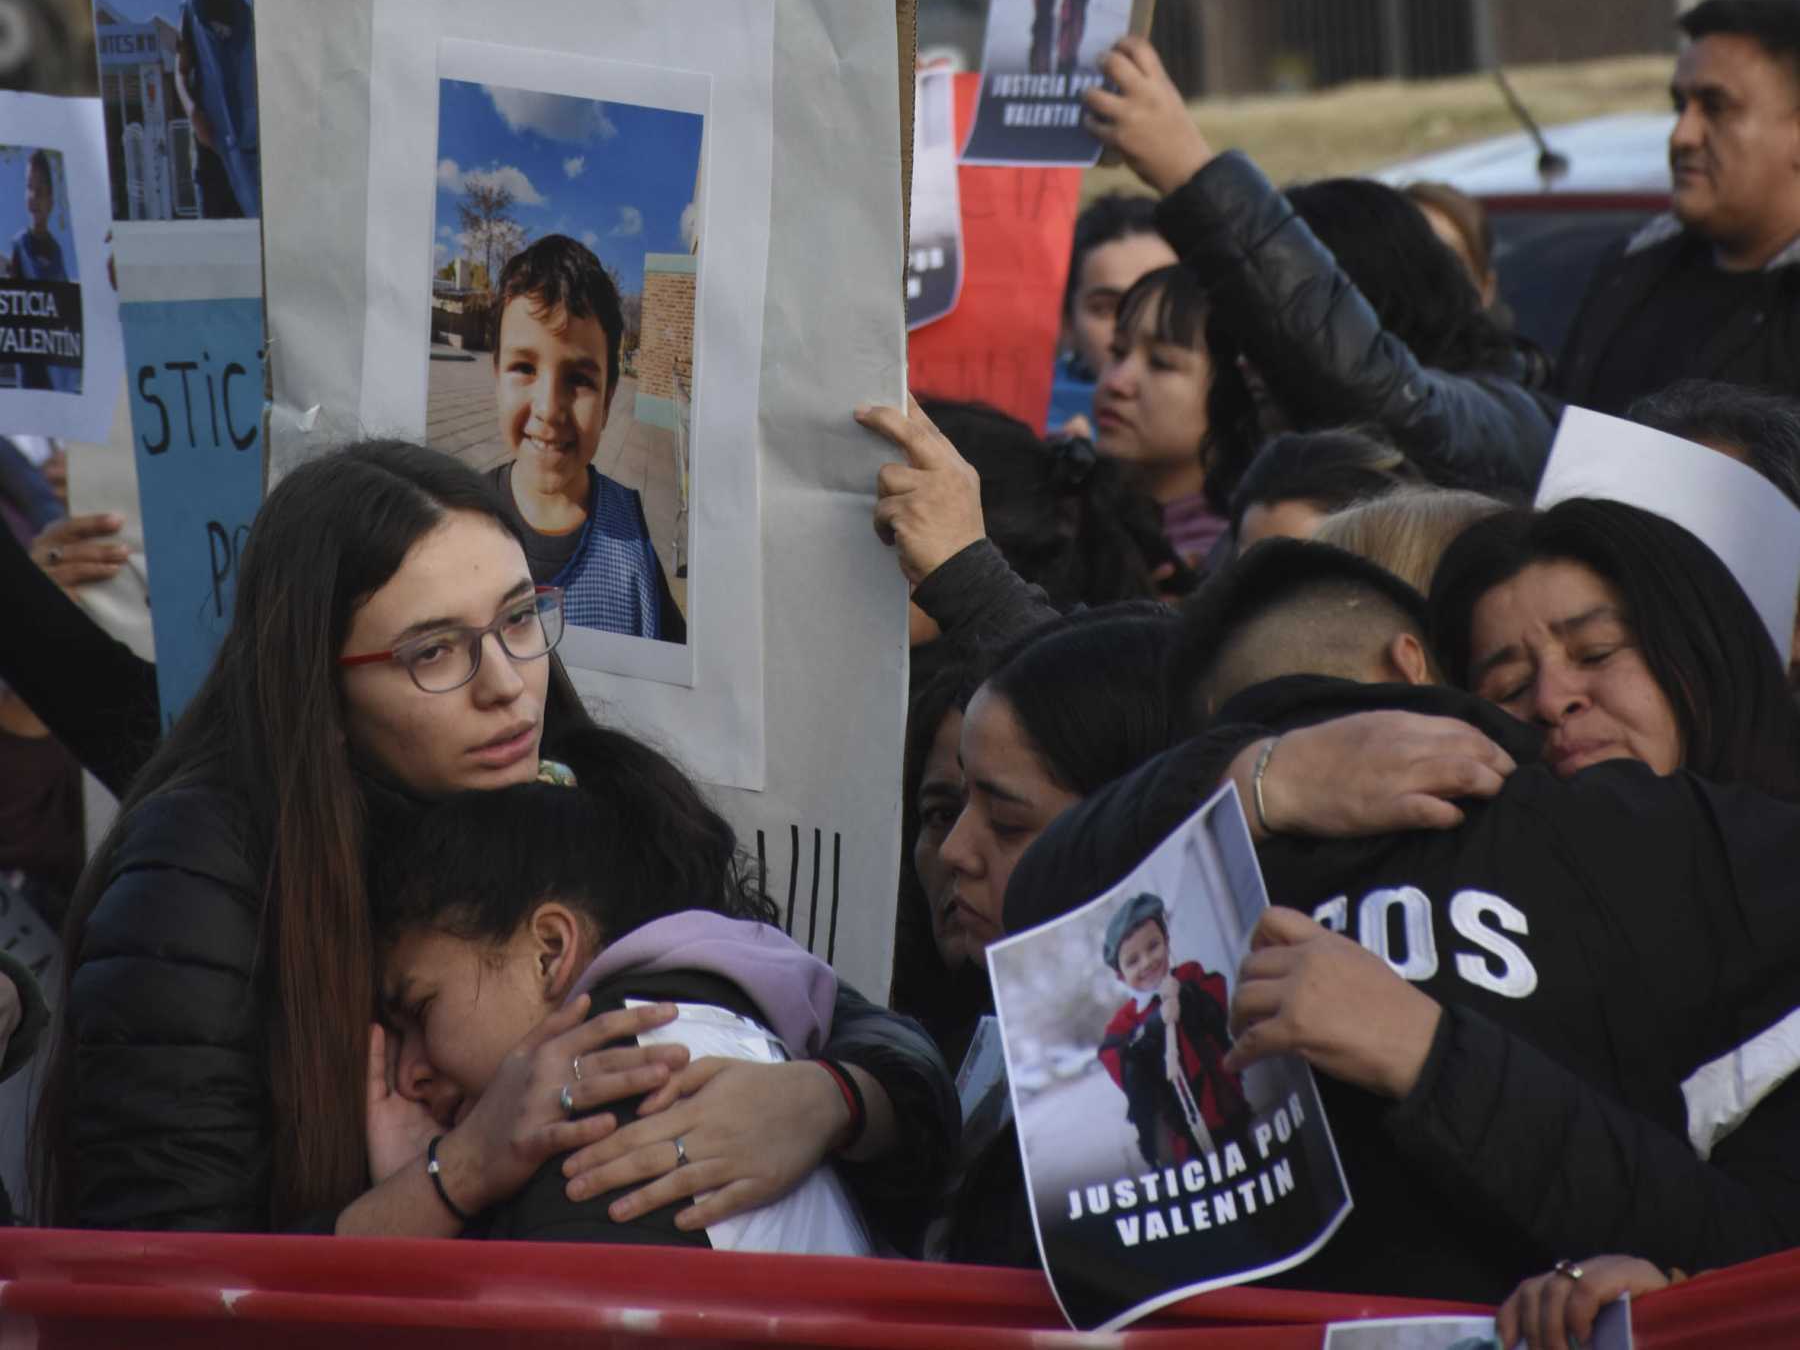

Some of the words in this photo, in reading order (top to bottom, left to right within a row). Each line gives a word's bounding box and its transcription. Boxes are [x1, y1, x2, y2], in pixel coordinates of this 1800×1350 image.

[991, 73, 1066, 98] JUSTICIA
[1068, 1141, 1247, 1220] JUSTICIA
[1254, 1091, 1305, 1160] POR
[1115, 1158, 1296, 1247] VALENTIN
